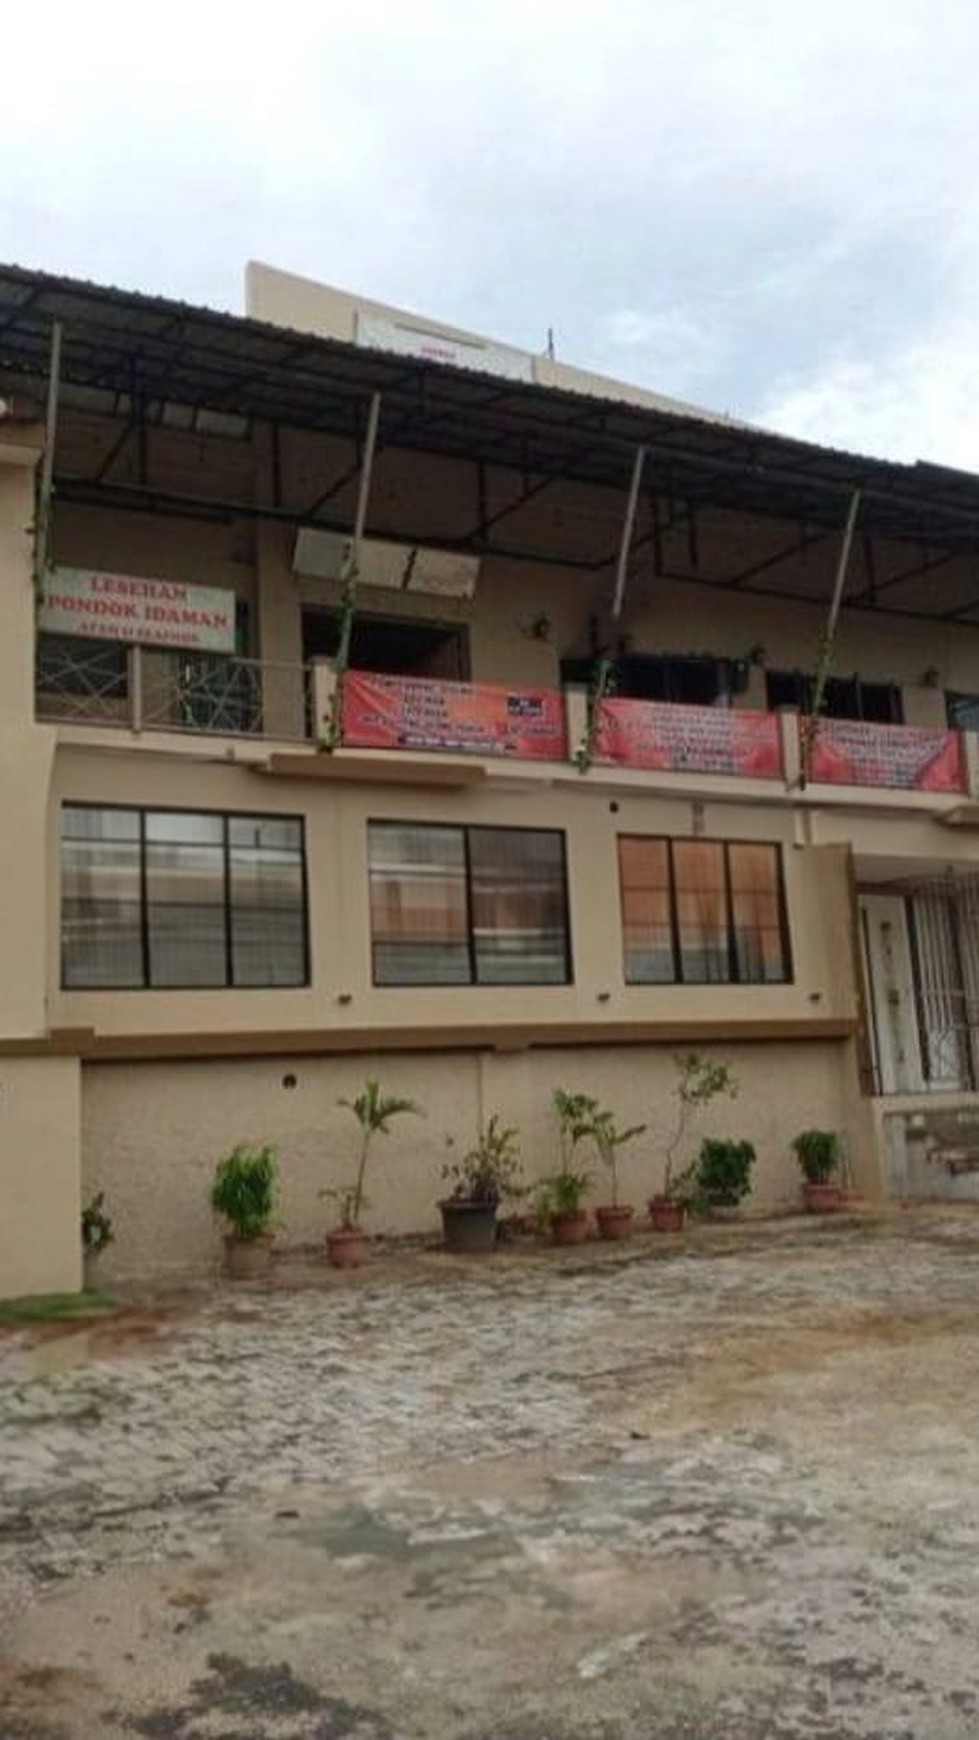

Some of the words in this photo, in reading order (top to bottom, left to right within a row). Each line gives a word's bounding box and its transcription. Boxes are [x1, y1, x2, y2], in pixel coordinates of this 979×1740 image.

[91, 576, 187, 599] LESEHAN
[47, 595, 137, 619] PONDOK
[144, 604, 228, 629] IDAMAN
